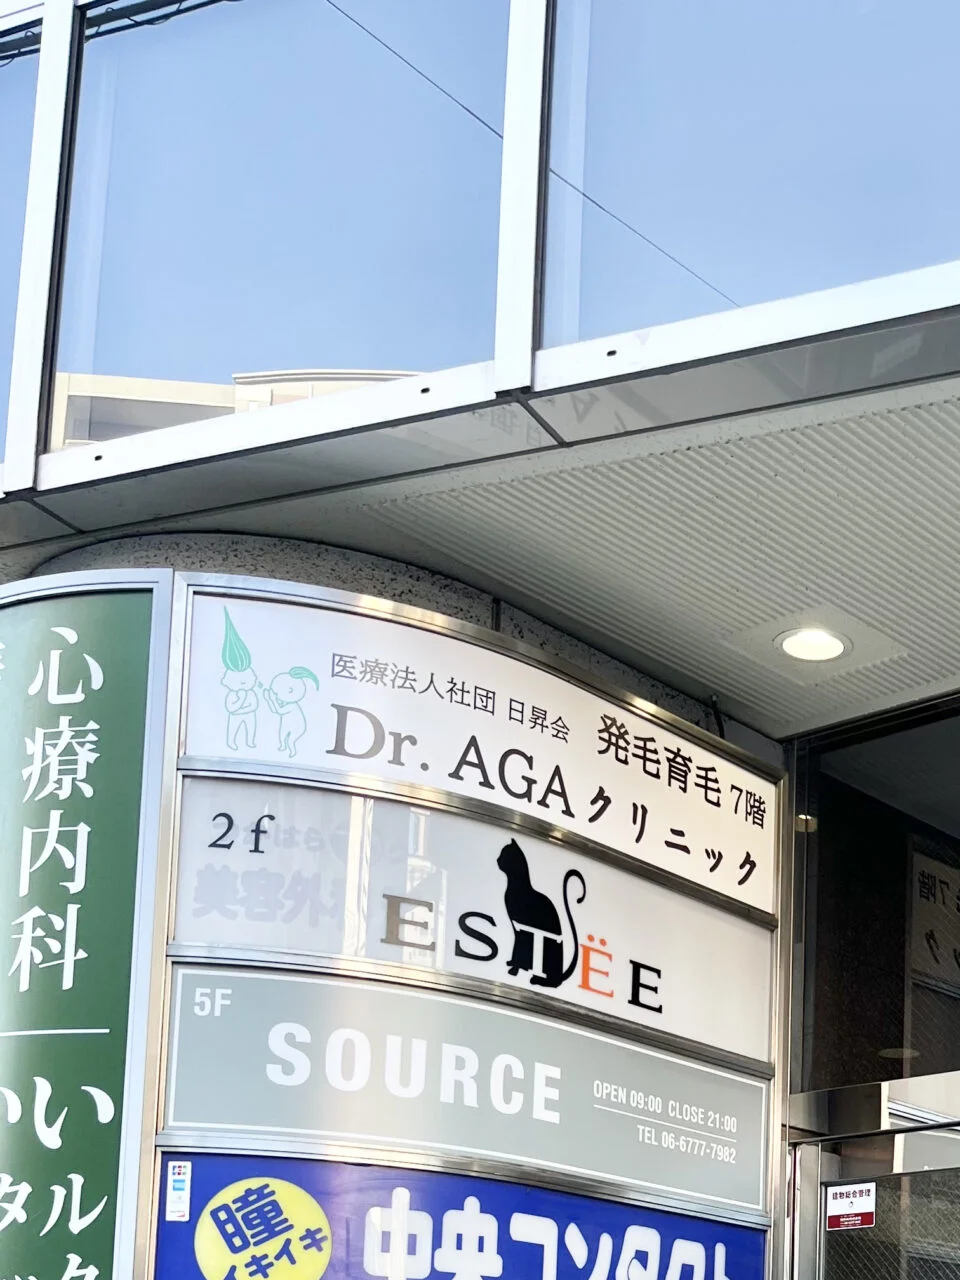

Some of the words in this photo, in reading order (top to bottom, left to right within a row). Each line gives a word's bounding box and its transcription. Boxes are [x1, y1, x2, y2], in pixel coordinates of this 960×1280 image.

[331, 652, 496, 716] 医療法人社団
[508, 697, 570, 744] 日昇会
[597, 713, 722, 809] 発毛育毛
[730, 784, 766, 830] 7階
[8, 625, 104, 993] 心療内科
[208, 811, 276, 854] 2f
[193, 987, 232, 1017] 5F
[265, 1021, 562, 1125] SOURCE
[593, 1080, 626, 1104] OPEN
[630, 1090, 662, 1113] 09:00
[668, 1100, 704, 1124] CLOSE
[707, 1111, 737, 1133] 21:00
[0, 1076, 114, 1150] い
[637, 1124, 658, 1145] TEL
[661, 1131, 736, 1164] 06-6777-7982
[210, 1183, 294, 1254] 瞳
